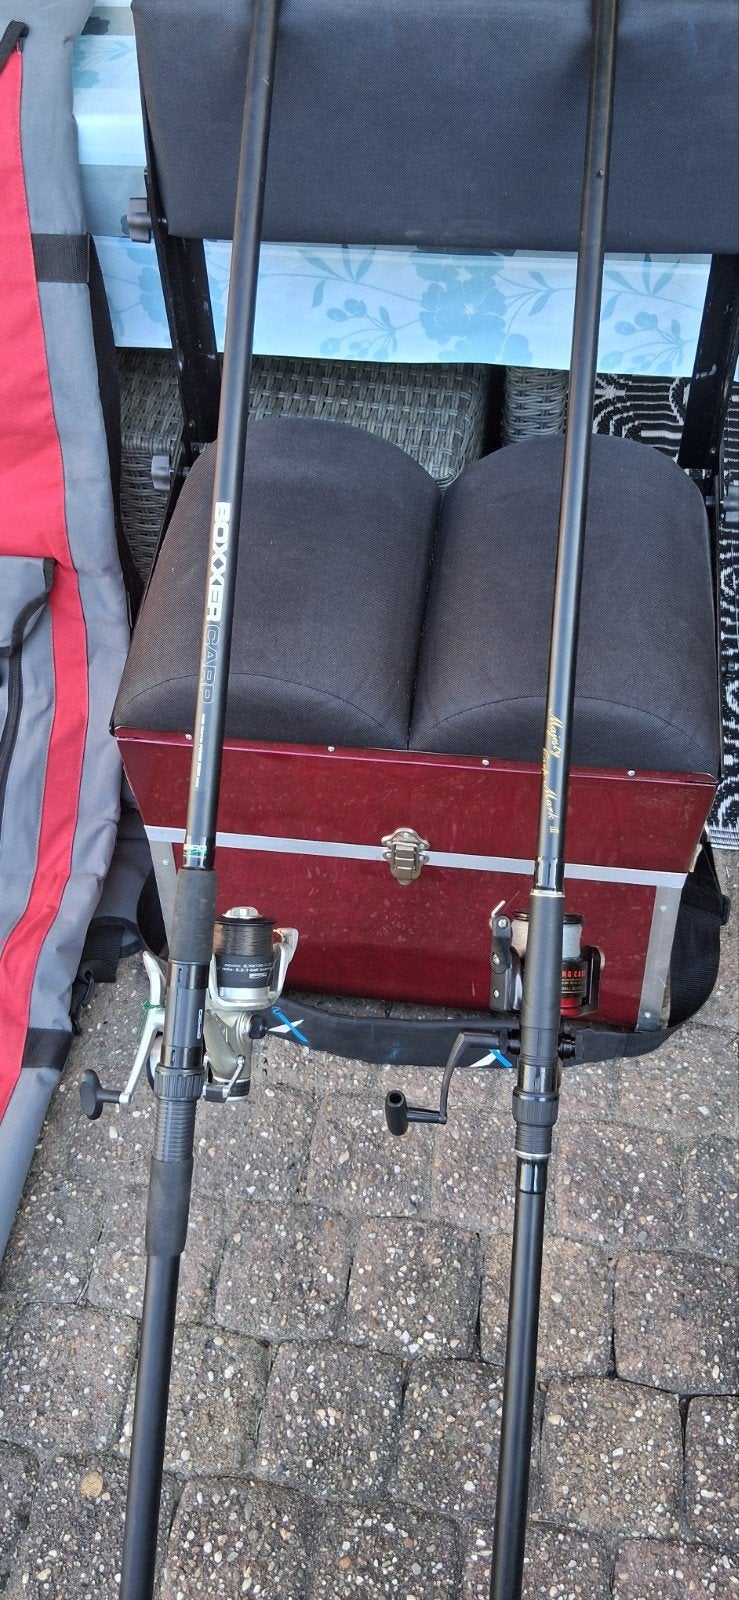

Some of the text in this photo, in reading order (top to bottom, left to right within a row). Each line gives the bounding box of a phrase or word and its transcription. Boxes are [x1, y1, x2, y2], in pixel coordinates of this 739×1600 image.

[206, 501, 231, 622] BOXXER
[201, 624, 220, 704] CARP
[543, 780, 559, 820] Mark
